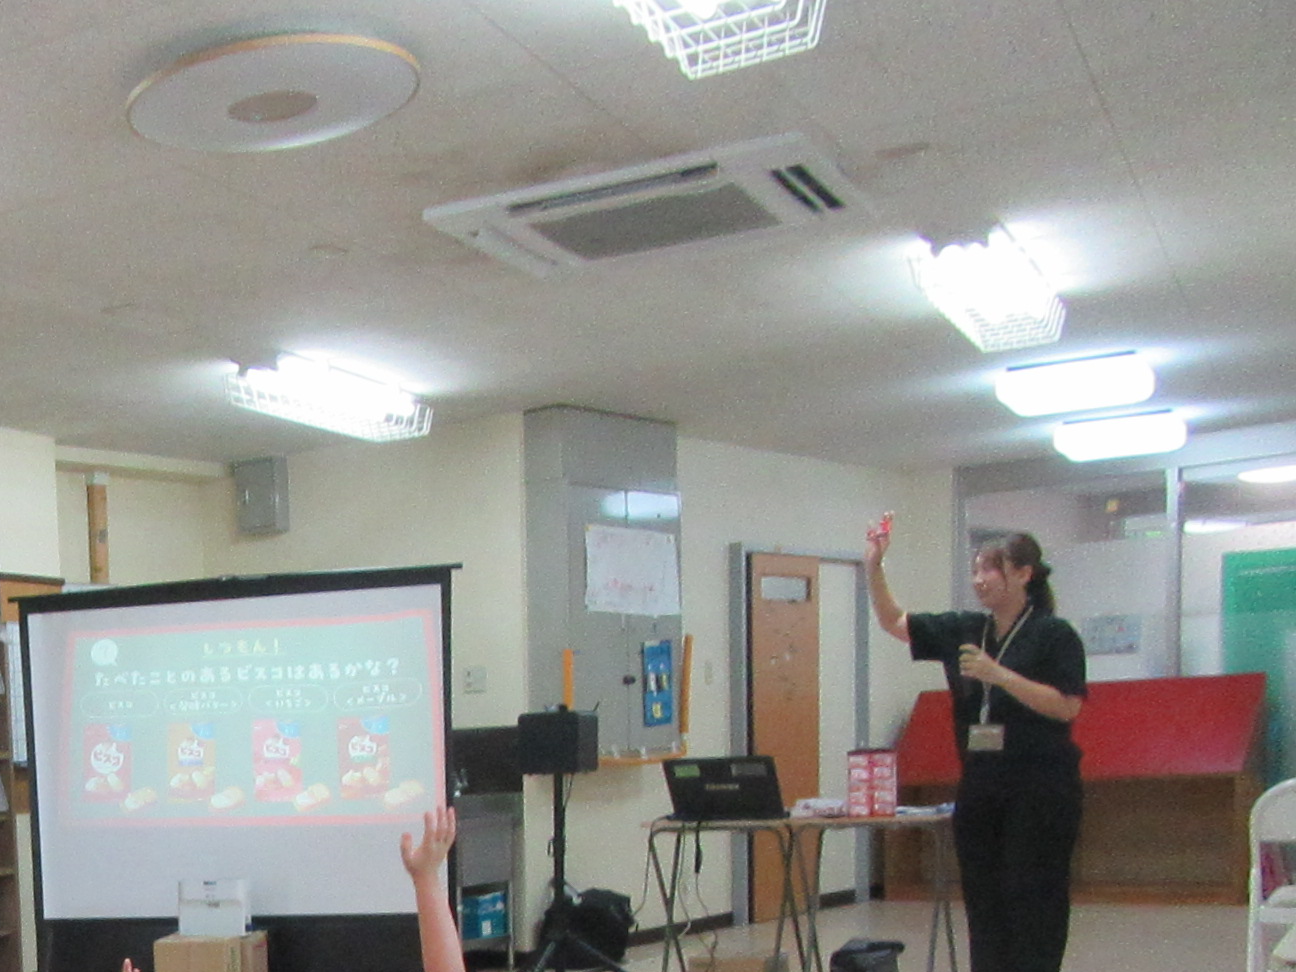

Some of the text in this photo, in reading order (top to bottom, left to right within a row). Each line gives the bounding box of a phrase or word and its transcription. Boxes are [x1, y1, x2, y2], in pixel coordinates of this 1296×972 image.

[204, 638, 279, 655] しつもん！
[95, 658, 400, 686] たべたことのあるビスコはあるかな？
[93, 748, 122, 768] ビスコ
